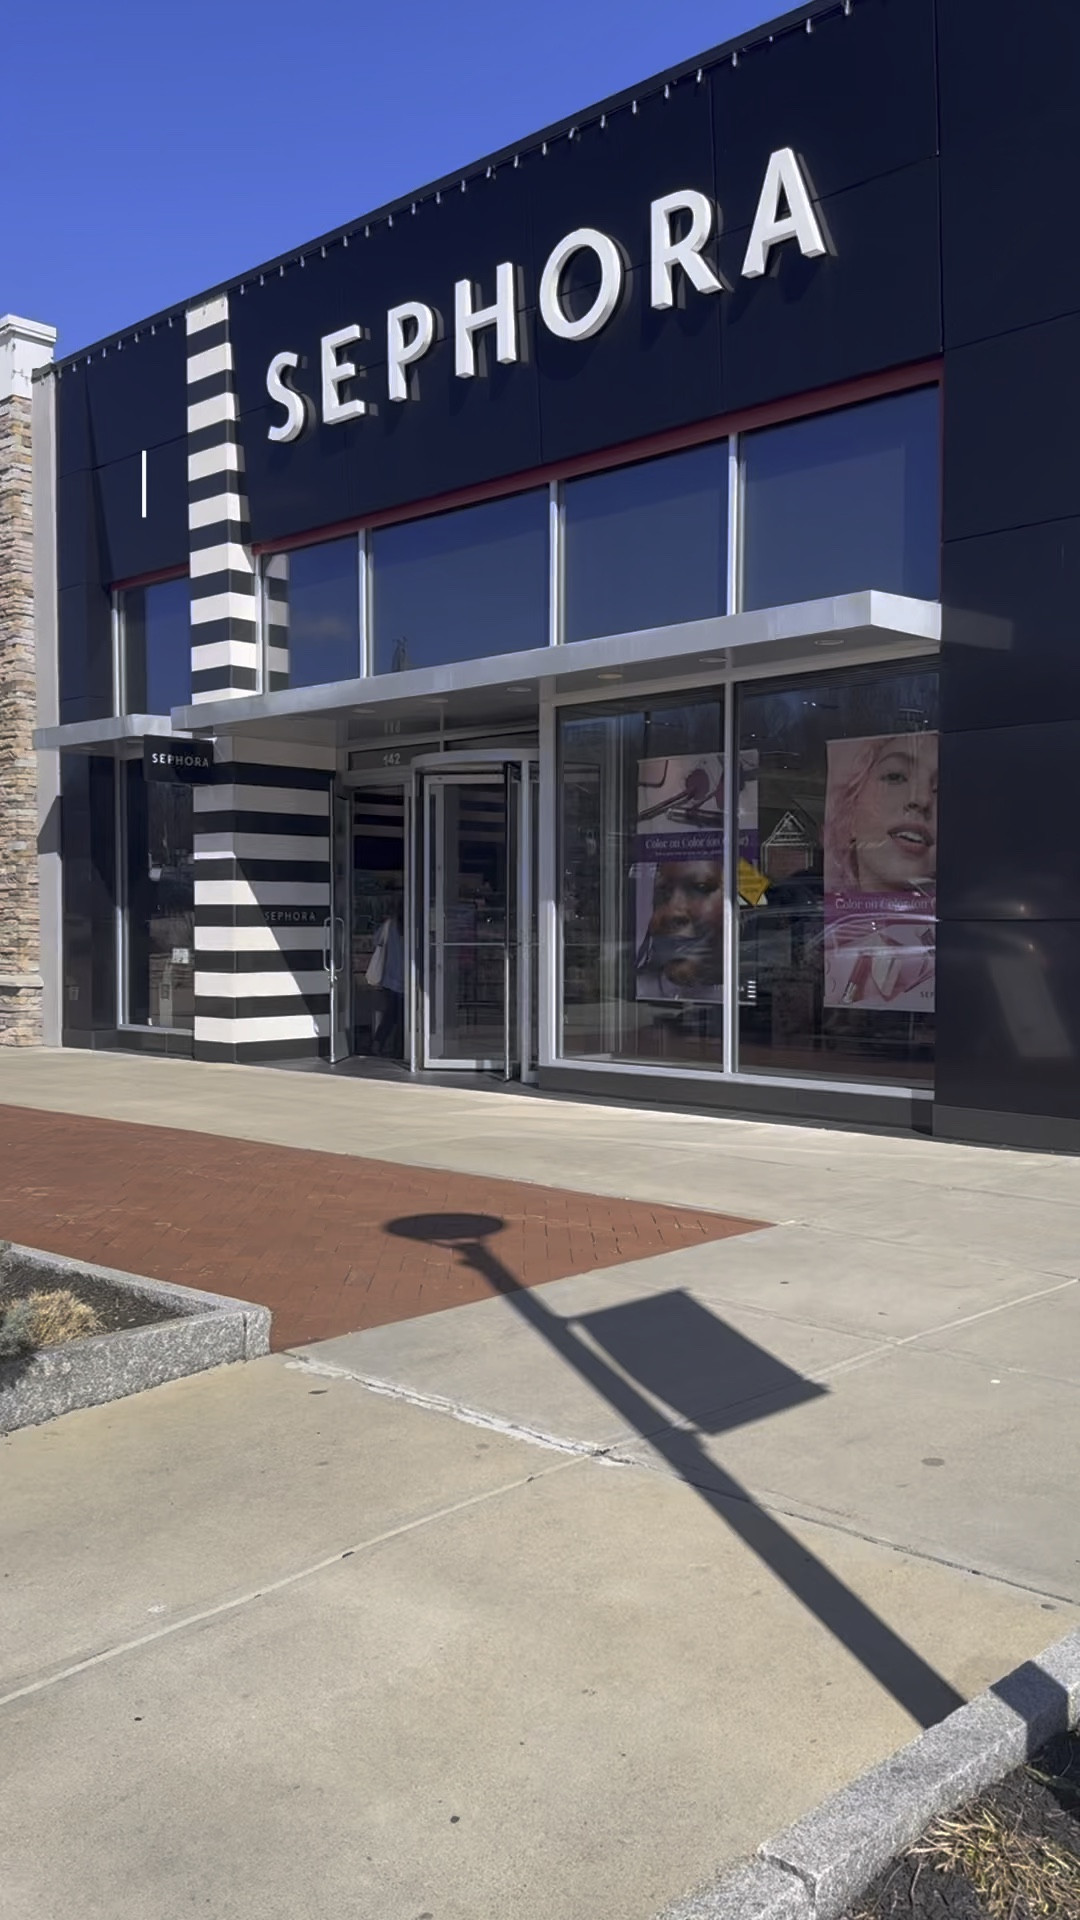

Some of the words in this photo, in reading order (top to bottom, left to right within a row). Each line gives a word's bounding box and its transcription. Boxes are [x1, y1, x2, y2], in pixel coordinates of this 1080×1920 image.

[266, 148, 827, 442] SEPHORA
[152, 753, 209, 767] SEPHORA
[645, 838, 668, 849] Color
[835, 898, 861, 909] Color
[264, 911, 316, 921] SEPHORA
